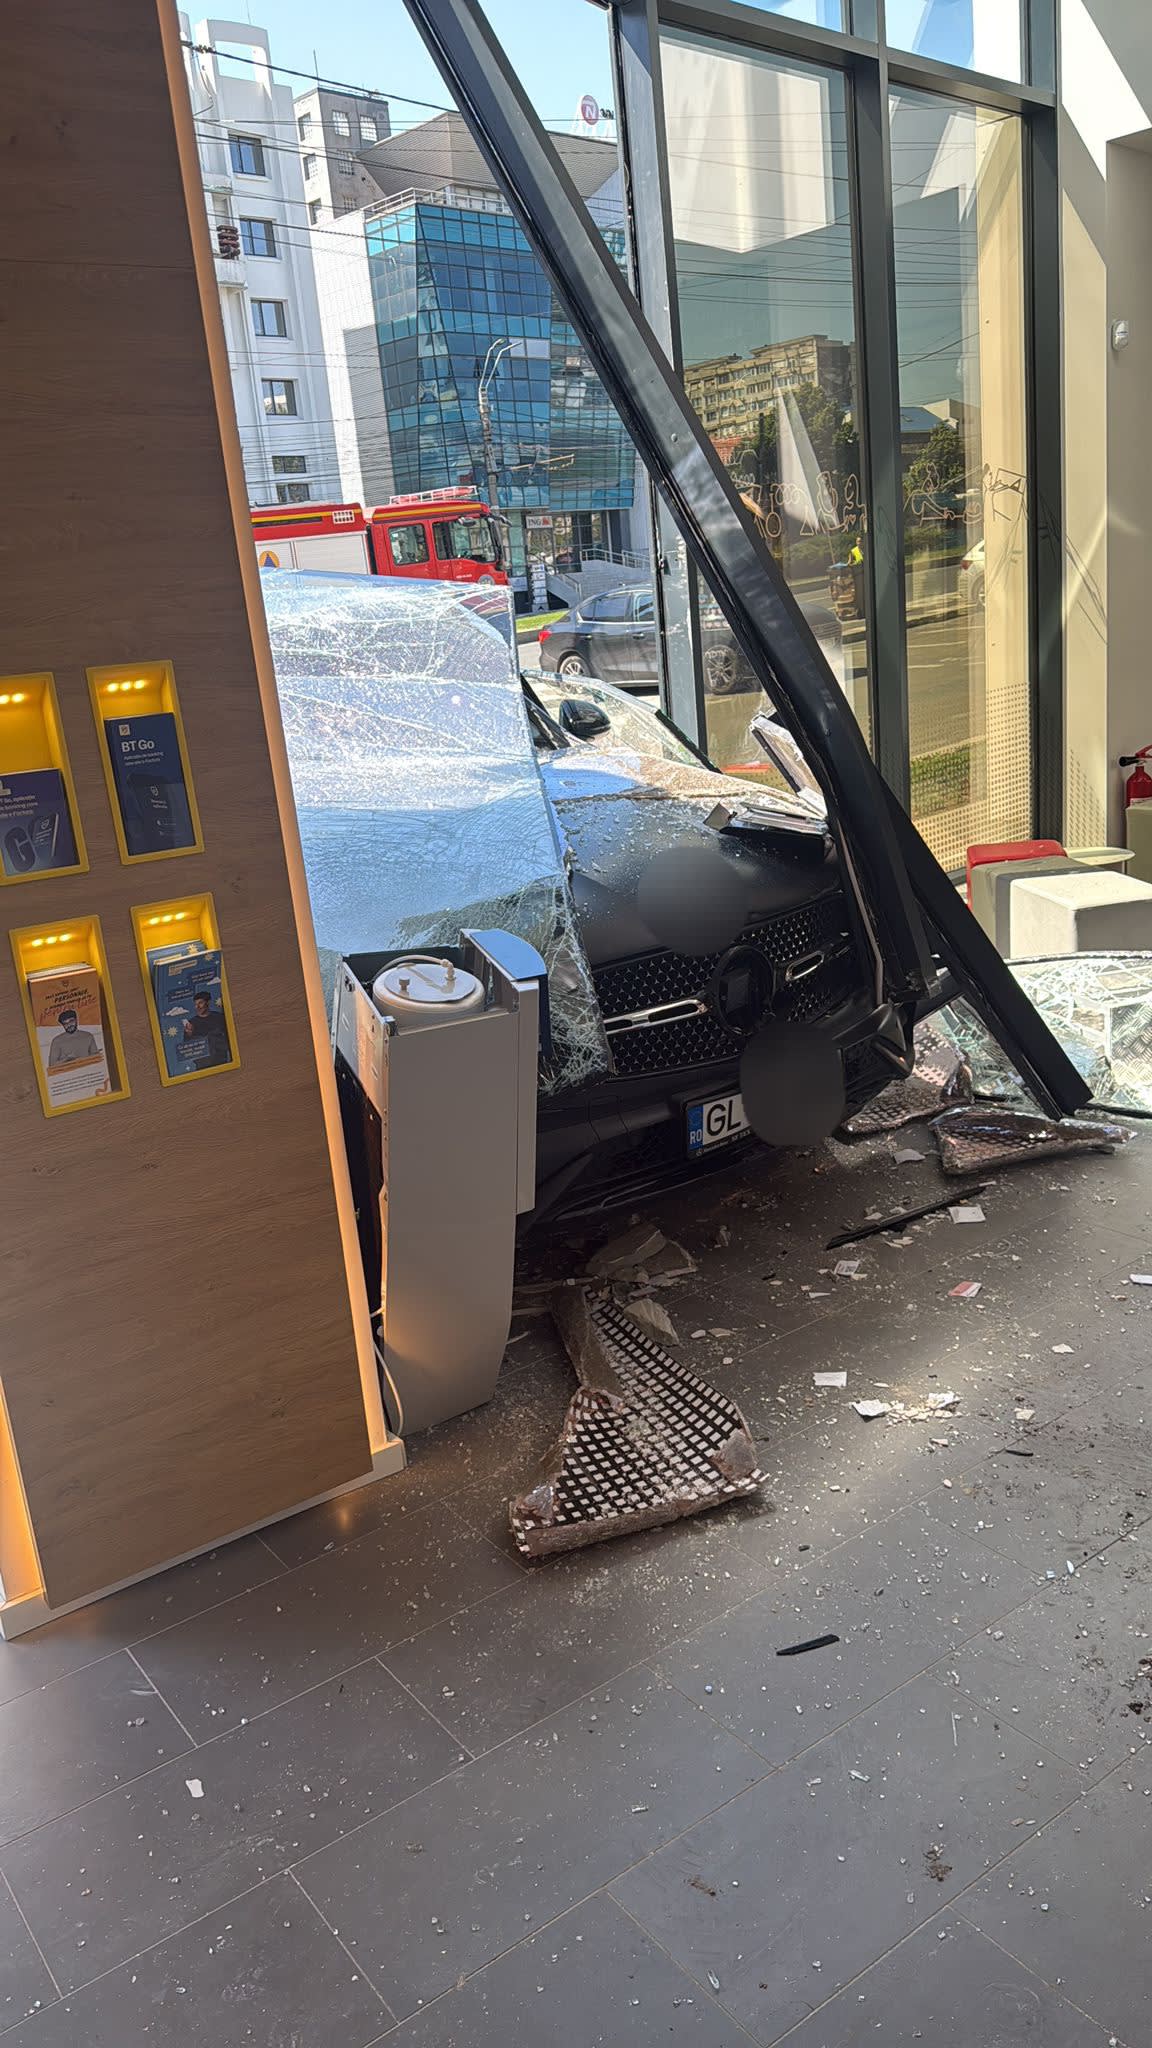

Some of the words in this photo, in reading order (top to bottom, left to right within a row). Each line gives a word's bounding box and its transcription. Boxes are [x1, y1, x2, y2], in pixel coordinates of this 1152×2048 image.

[528, 518, 541, 527] ING
[121, 741, 136, 753] BT
[138, 739, 155, 750] Go
[690, 1129, 703, 1145] RO
[707, 1100, 741, 1136] GL
